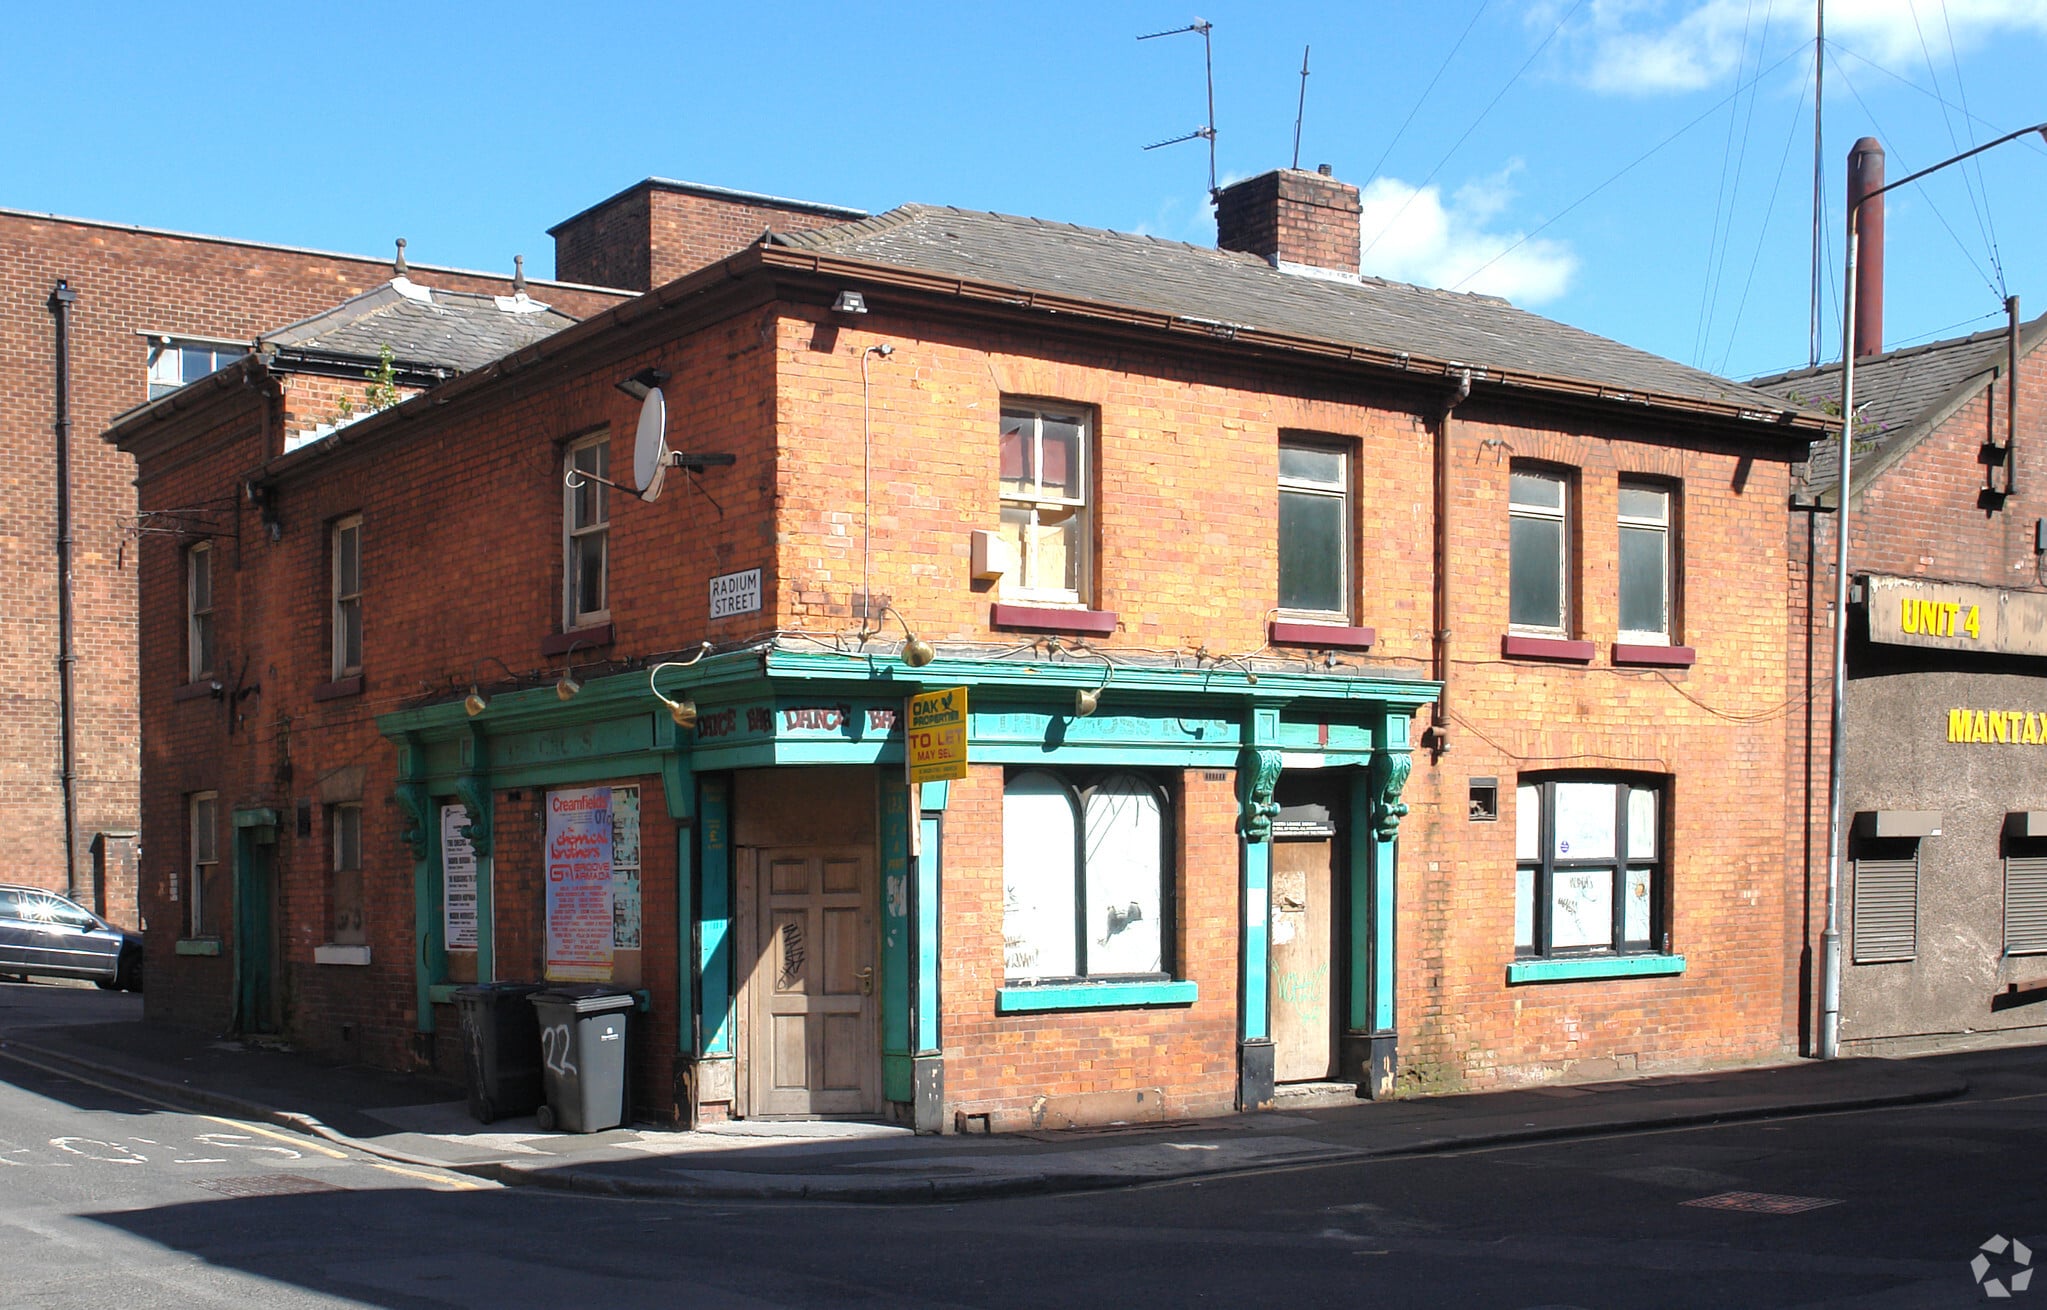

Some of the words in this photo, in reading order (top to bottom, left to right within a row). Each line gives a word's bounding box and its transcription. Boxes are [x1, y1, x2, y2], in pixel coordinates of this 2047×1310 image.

[713, 573, 757, 597] RADIUM
[715, 592, 755, 615] STREET
[1901, 598, 1961, 637] UNIT
[1964, 604, 1981, 640] 4
[783, 703, 851, 731] DANCE
[912, 699, 939, 716] OAK
[697, 708, 736, 738] DANCE
[747, 707, 774, 733] BAR
[909, 733, 932, 749] TO
[937, 728, 963, 746] LET
[917, 749, 935, 761] MAY
[573, 862, 610, 874] GROOVE
[541, 1024, 577, 1076] 22
